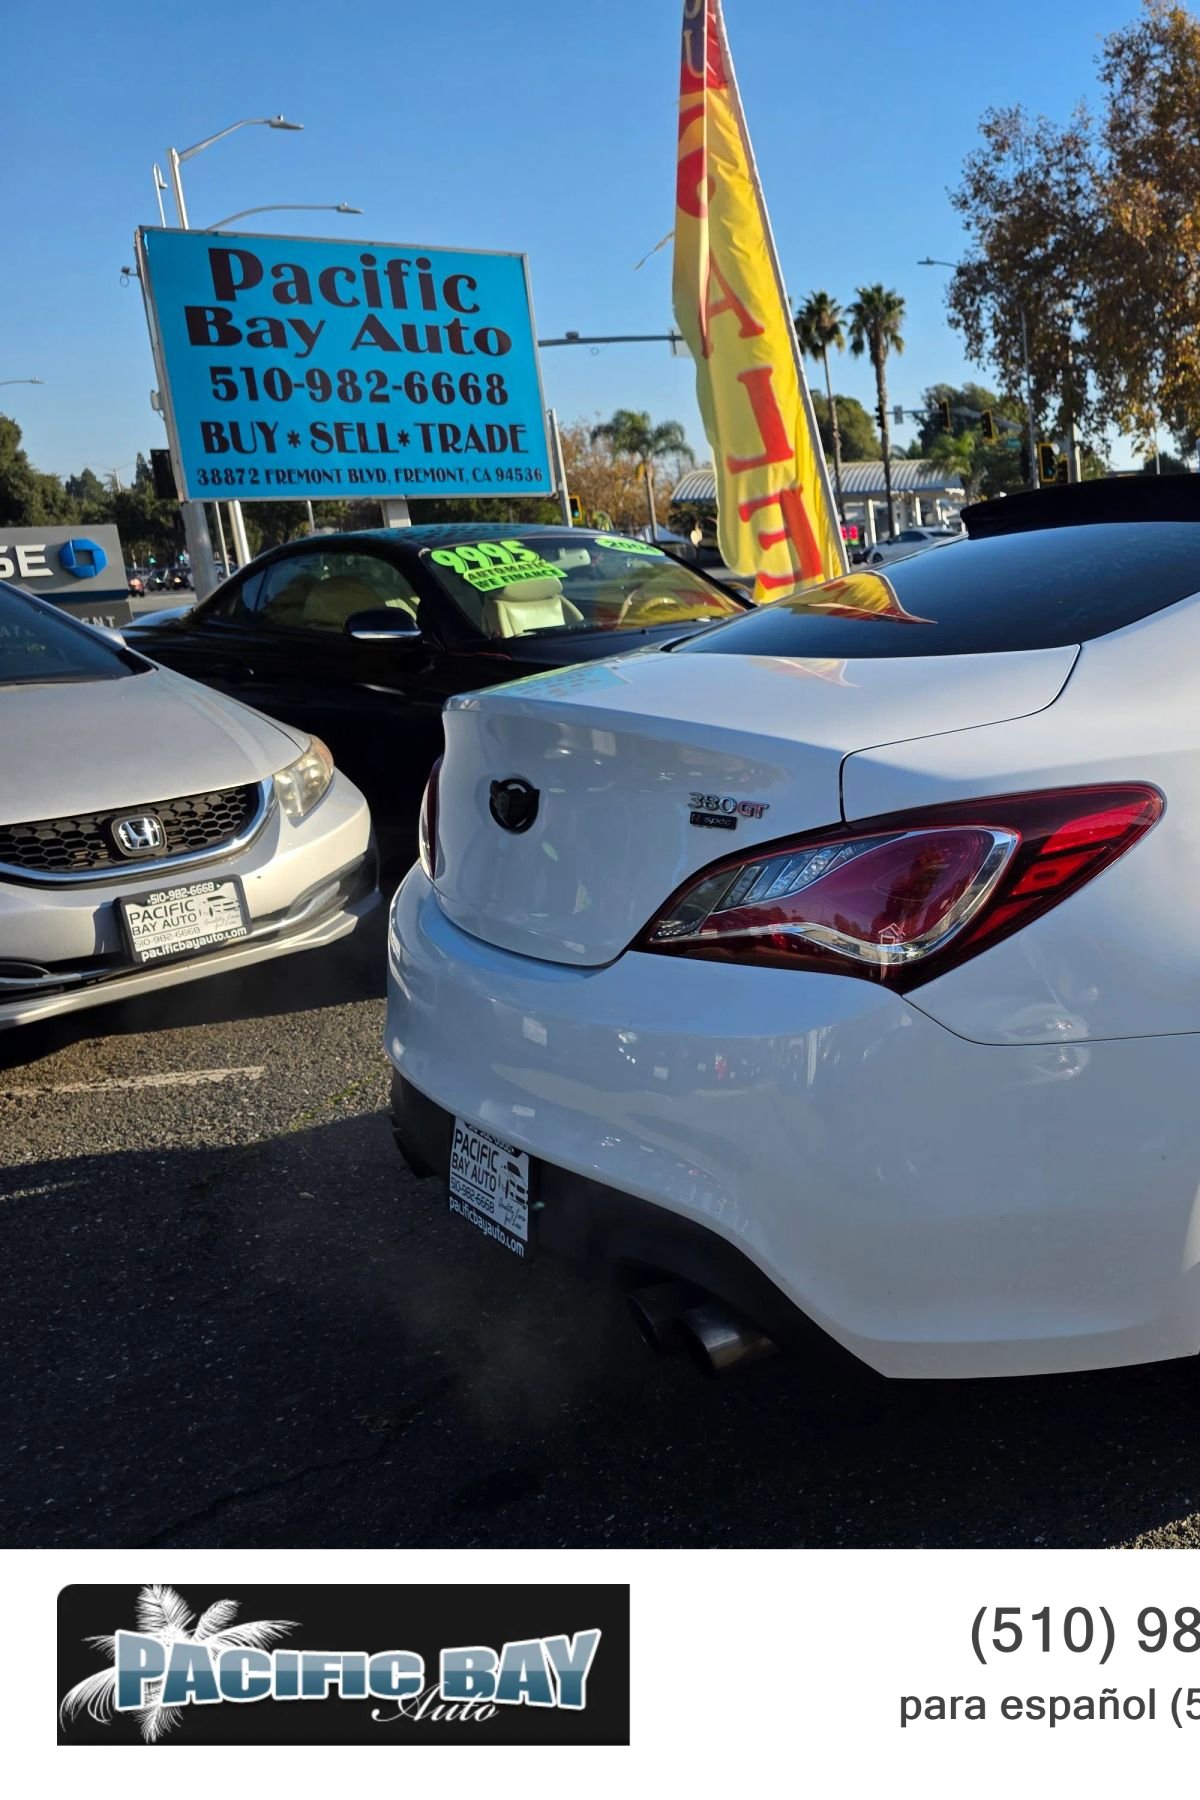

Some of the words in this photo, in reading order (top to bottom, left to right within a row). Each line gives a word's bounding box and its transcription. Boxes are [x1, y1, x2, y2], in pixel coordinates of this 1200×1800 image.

[208, 247, 480, 314] Pacific
[184, 305, 326, 358] Bay
[350, 313, 512, 357] Auto
[209, 366, 509, 406] 510-982-6668
[200, 421, 279, 455] BUY
[310, 421, 399, 454] SELL
[414, 422, 529, 455] TRADE
[197, 468, 261, 486] 38872
[265, 468, 342, 486] FREMONT
[472, 467, 492, 483] CA
[495, 467, 543, 483] 94536
[431, 540, 539, 574] 9995
[468, 559, 546, 581] AUTOMATIC
[150, 882, 215, 905] 510-982-6668
[129, 900, 195, 925] PACIFIC
[132, 921, 156, 937] BAY
[162, 913, 197, 929] AUTO
[134, 926, 200, 949] 510-982-6668
[141, 926, 247, 963] pacificbayauto.com
[454, 1128, 500, 1174] PACIFIC
[451, 1151, 470, 1175] BAY
[471, 1164, 497, 1192] AUTO
[451, 1177, 495, 1214] 510-982-6668
[450, 1197, 525, 1258] pacificbayauto.com
